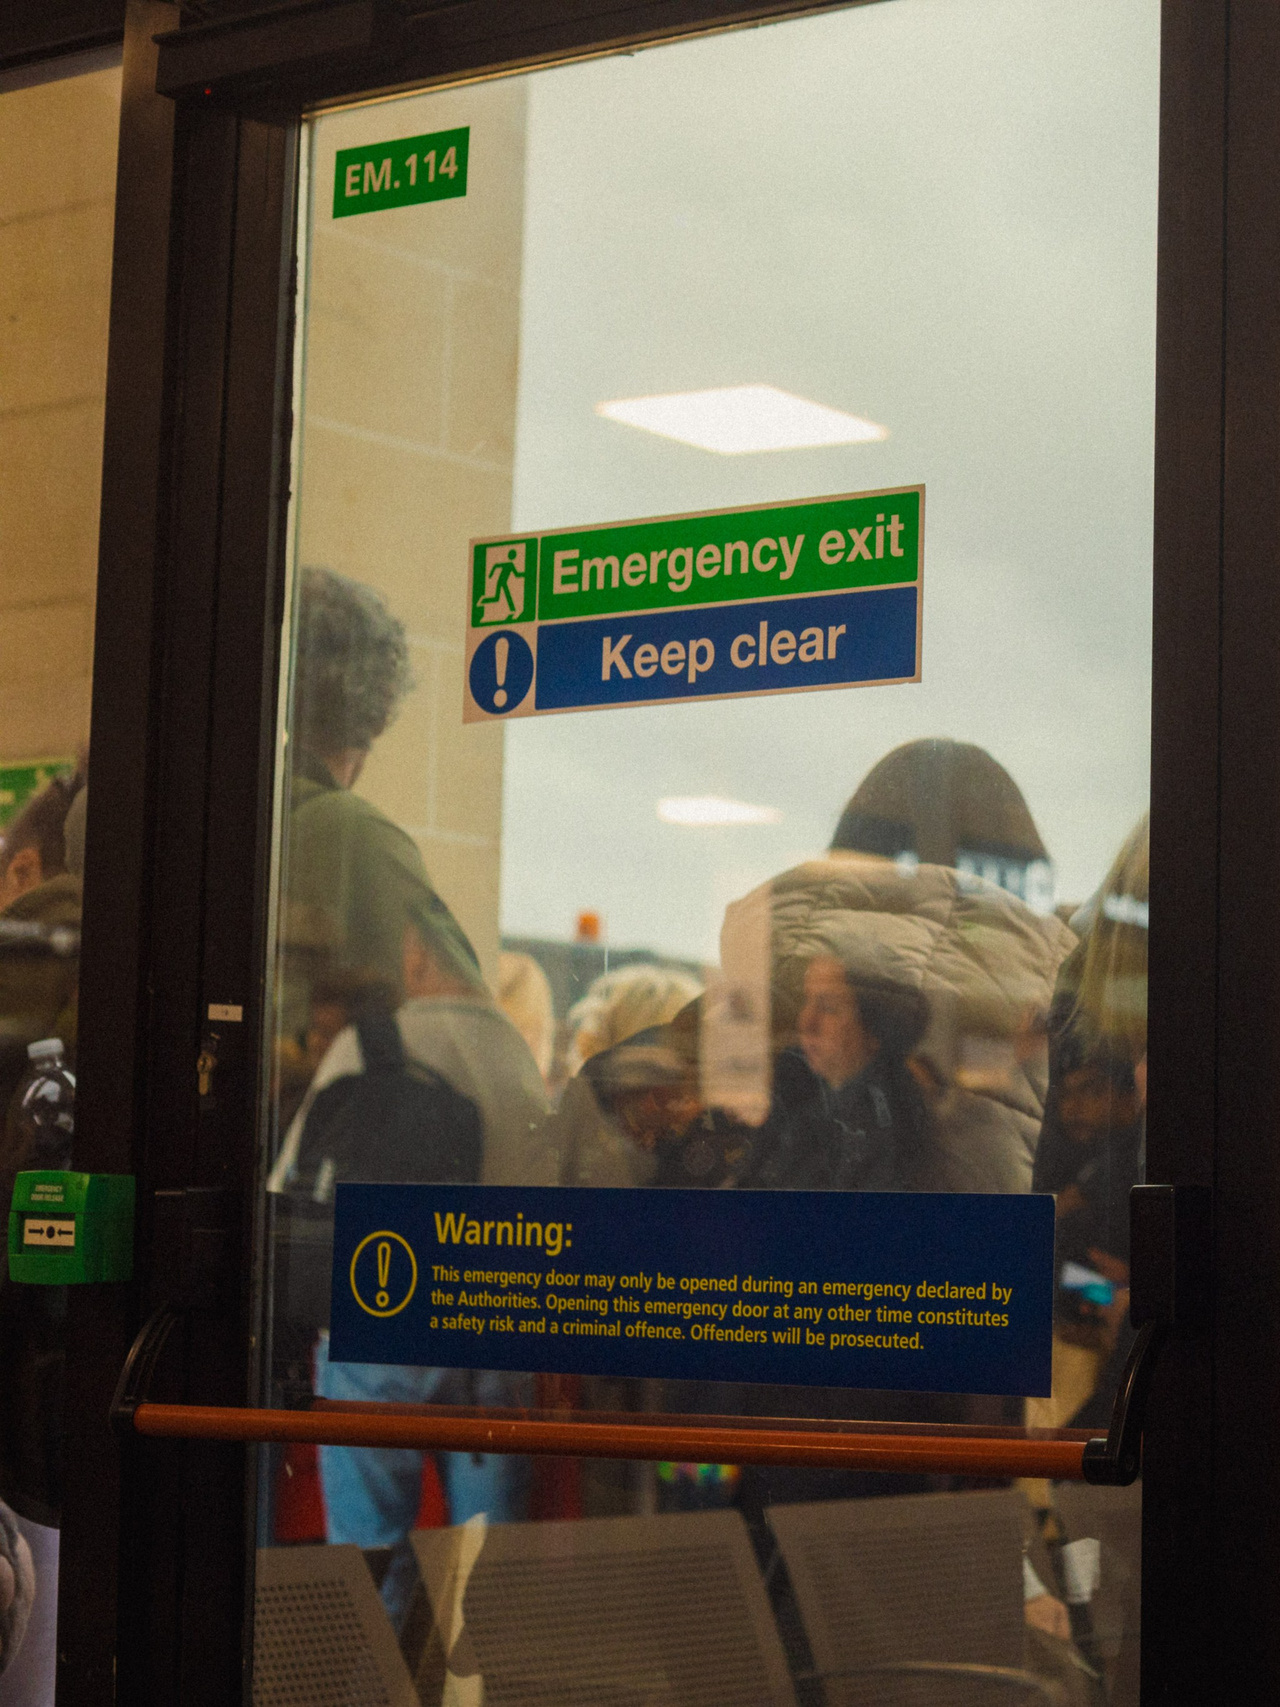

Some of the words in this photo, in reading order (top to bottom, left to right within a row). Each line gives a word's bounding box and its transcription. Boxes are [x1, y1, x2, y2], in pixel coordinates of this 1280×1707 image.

[345, 146, 458, 198] EM.114
[553, 534, 805, 593] Emergency
[818, 514, 905, 565] exit
[602, 634, 715, 683] Keep
[730, 621, 846, 669] clear
[434, 1211, 573, 1256] Warning:
[432, 1265, 460, 1282] This
[464, 1270, 542, 1289] emergency
[546, 1269, 580, 1286] door
[584, 1275, 615, 1291] may
[620, 1272, 652, 1293] only
[657, 1272, 675, 1289] be
[680, 1275, 737, 1294] opened
[742, 1275, 793, 1298] during
[798, 1281, 818, 1294] an
[823, 1282, 911, 1302] emergency
[916, 1281, 986, 1300] declared
[992, 1283, 1012, 1305] by
[431, 1289, 454, 1305] the
[458, 1291, 540, 1309] Authorities.
[546, 1294, 608, 1316] Opening
[613, 1296, 640, 1313] this
[644, 1301, 728, 1320] emergency
[732, 1300, 769, 1318] door
[773, 1304, 789, 1319] at
[794, 1307, 823, 1324] any
[827, 1304, 871, 1322] other
[876, 1306, 912, 1323] time
[917, 1308, 1009, 1327] constitutes
[430, 1317, 438, 1328] a
[442, 1313, 485, 1334] safety
[490, 1316, 514, 1331] risk
[518, 1317, 546, 1333] and
[550, 1322, 558, 1334] a
[563, 1319, 621, 1336] criminal
[625, 1321, 685, 1339] offence.
[690, 1323, 767, 1343] Offenders
[772, 1327, 800, 1344] will
[806, 1328, 825, 1345] be
[830, 1332, 923, 1349] prosecuted.
